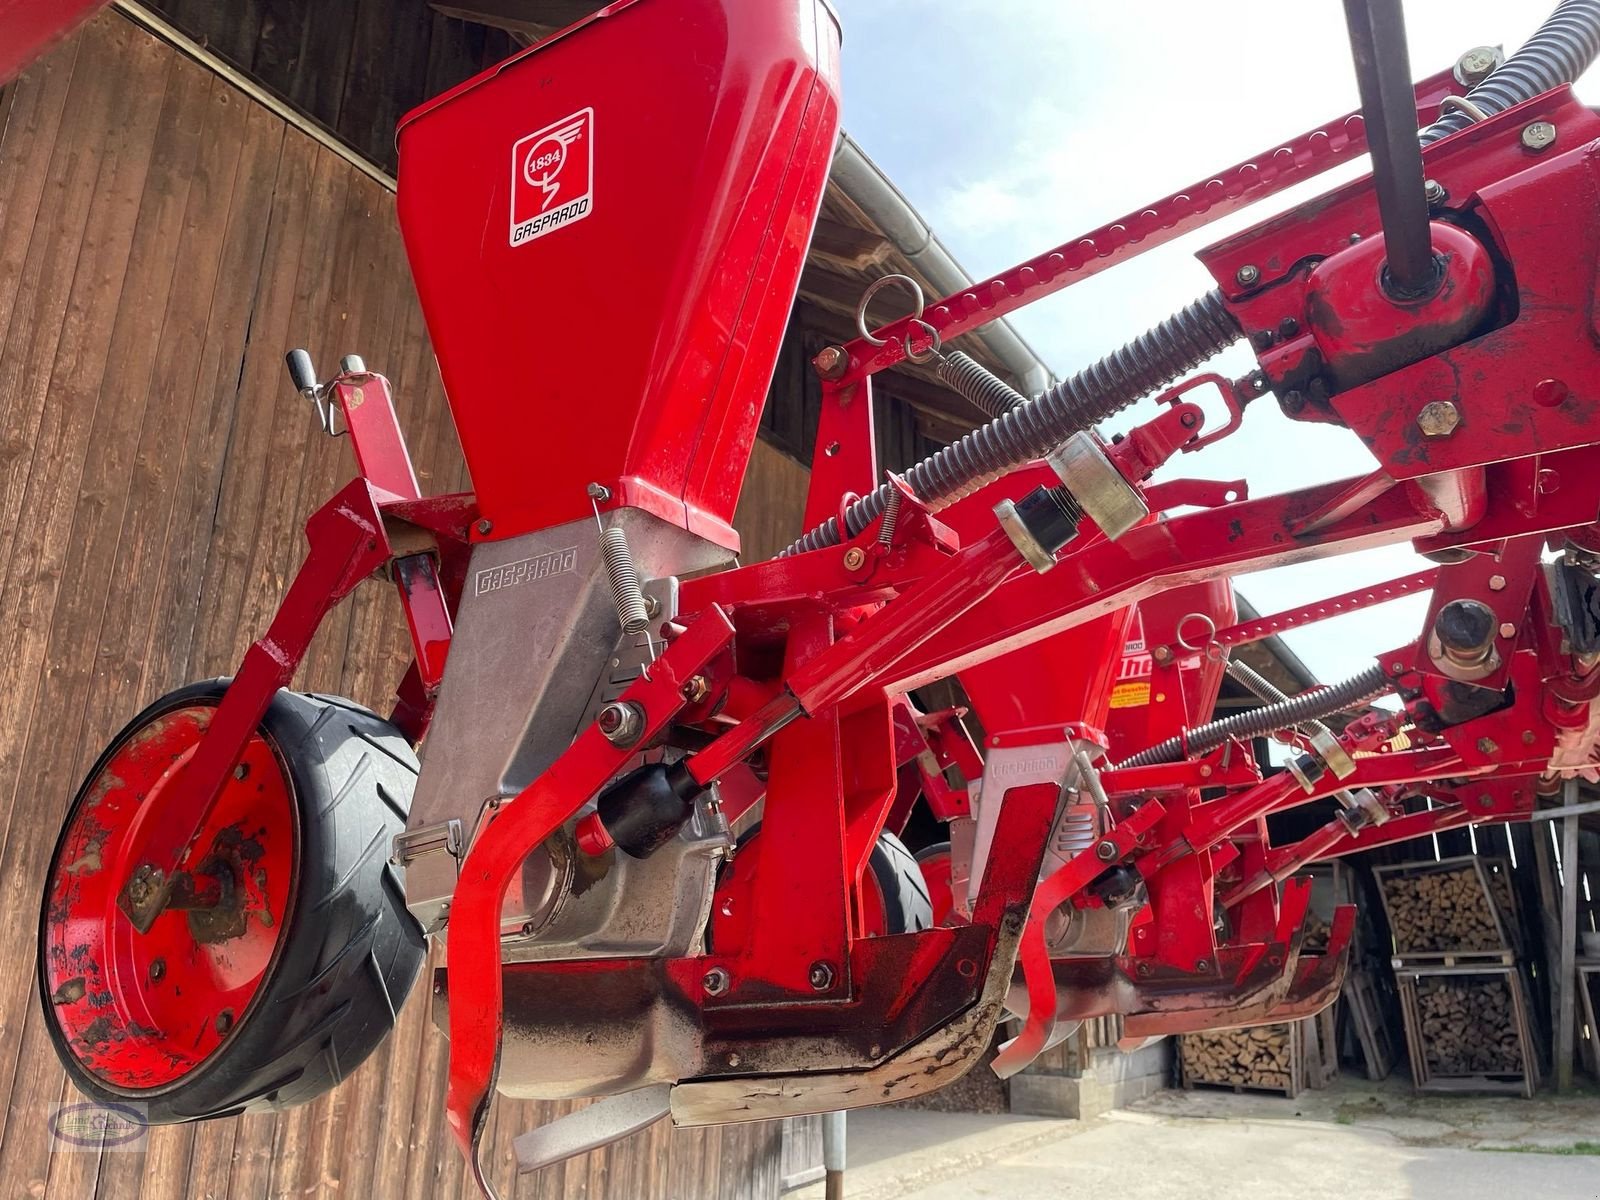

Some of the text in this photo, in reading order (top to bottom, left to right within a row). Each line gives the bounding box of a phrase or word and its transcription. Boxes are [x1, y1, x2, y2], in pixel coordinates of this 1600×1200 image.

[529, 149, 561, 173] 1834
[513, 198, 589, 243] GASPARDO
[478, 549, 577, 594] GASPARDO
